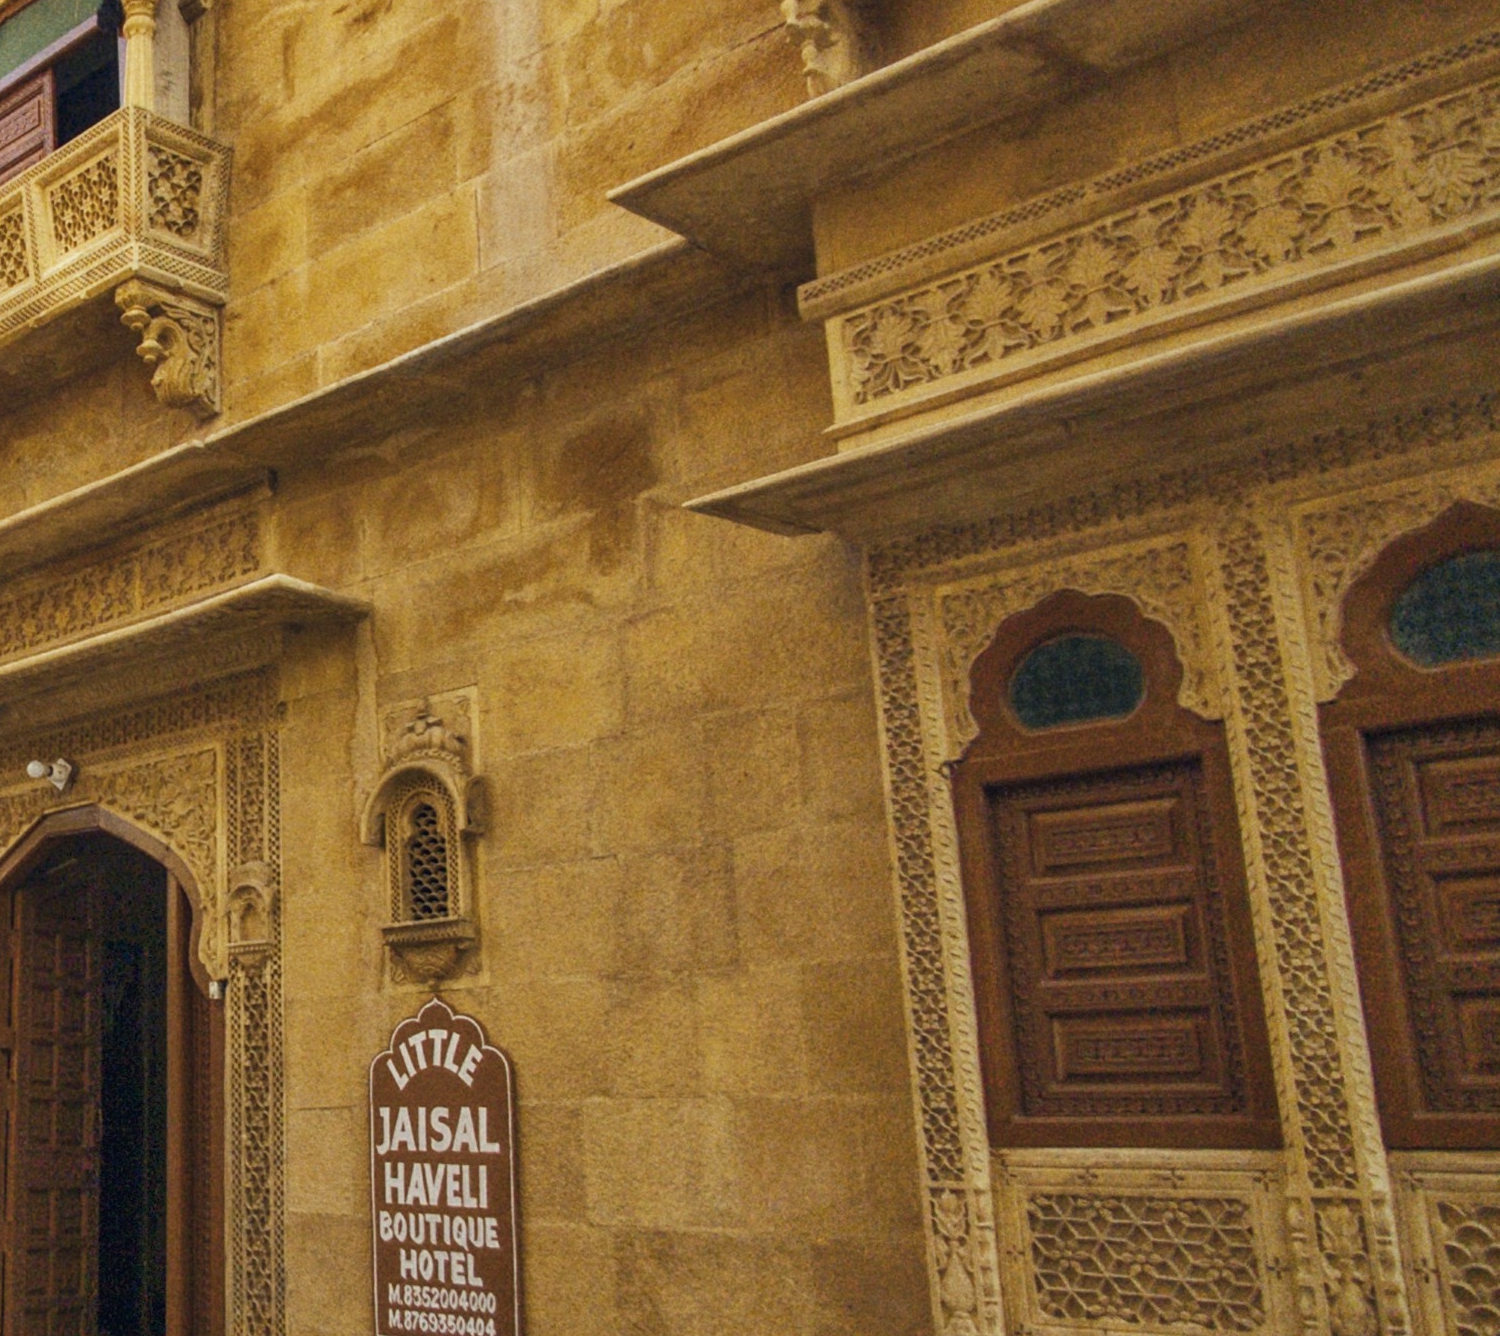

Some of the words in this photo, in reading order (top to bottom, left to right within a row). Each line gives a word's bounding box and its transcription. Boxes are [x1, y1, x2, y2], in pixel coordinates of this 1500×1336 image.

[386, 1029, 483, 1090] LITTLE
[376, 1106, 500, 1155] JAISAL
[384, 1162, 488, 1209] HAVELI
[379, 1210, 500, 1251] BOUTIQUE
[400, 1248, 483, 1287] HOTEL
